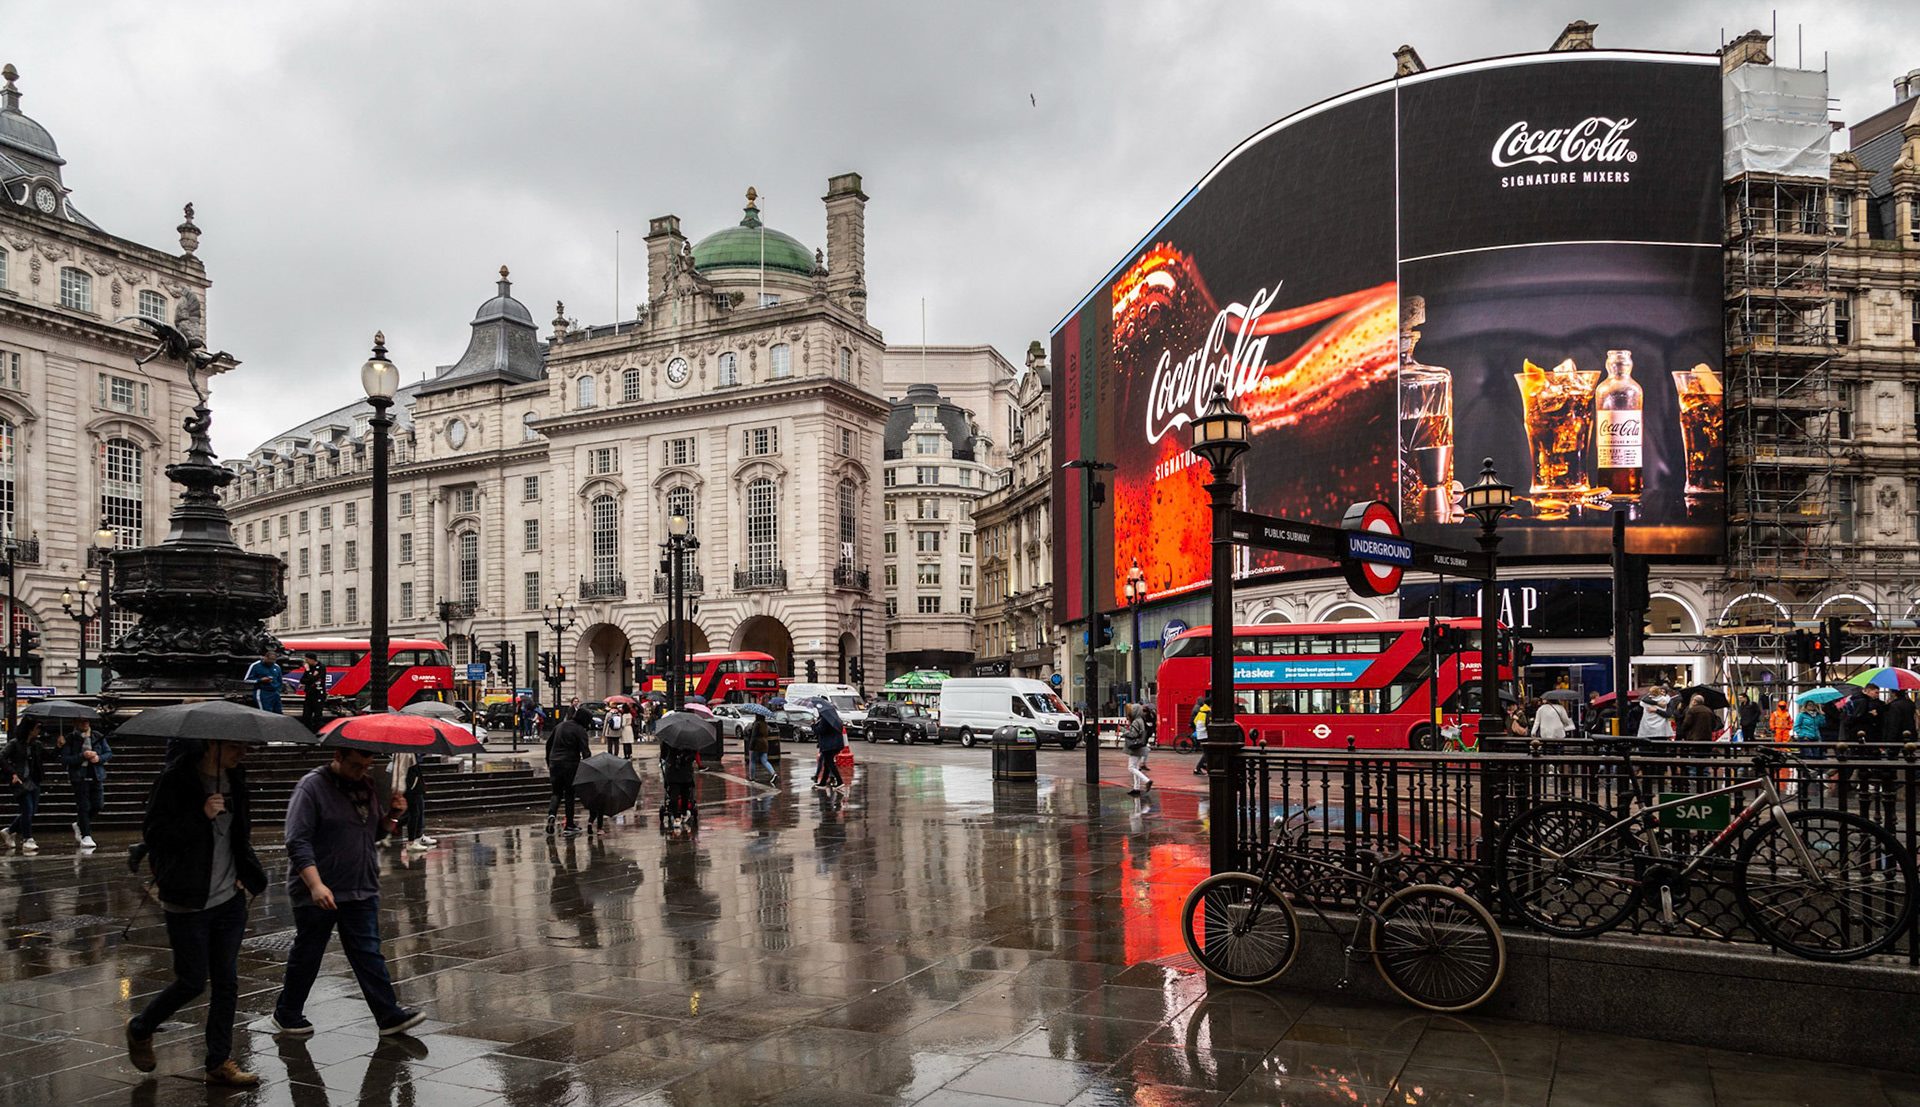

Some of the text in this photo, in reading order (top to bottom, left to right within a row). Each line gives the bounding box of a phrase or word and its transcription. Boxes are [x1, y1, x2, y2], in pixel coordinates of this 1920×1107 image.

[1491, 116, 1638, 168] Coca-Cola
[1501, 171, 1631, 188] SIGNATURE MIXERS
[1146, 280, 1283, 445] Coca-Cola
[1599, 419, 1640, 437] Coca-Cola
[1264, 527, 1286, 540] PUBLIC
[1286, 531, 1311, 544] SUBWAY
[1349, 538, 1412, 560] UNDERGROUND
[1434, 554, 1468, 567] PUBLIC SUBWAY
[1477, 587, 1537, 628] AP
[1164, 626, 1183, 648] Boot
[1234, 667, 1275, 679] irtasker
[1675, 805, 1713, 819] SAP
